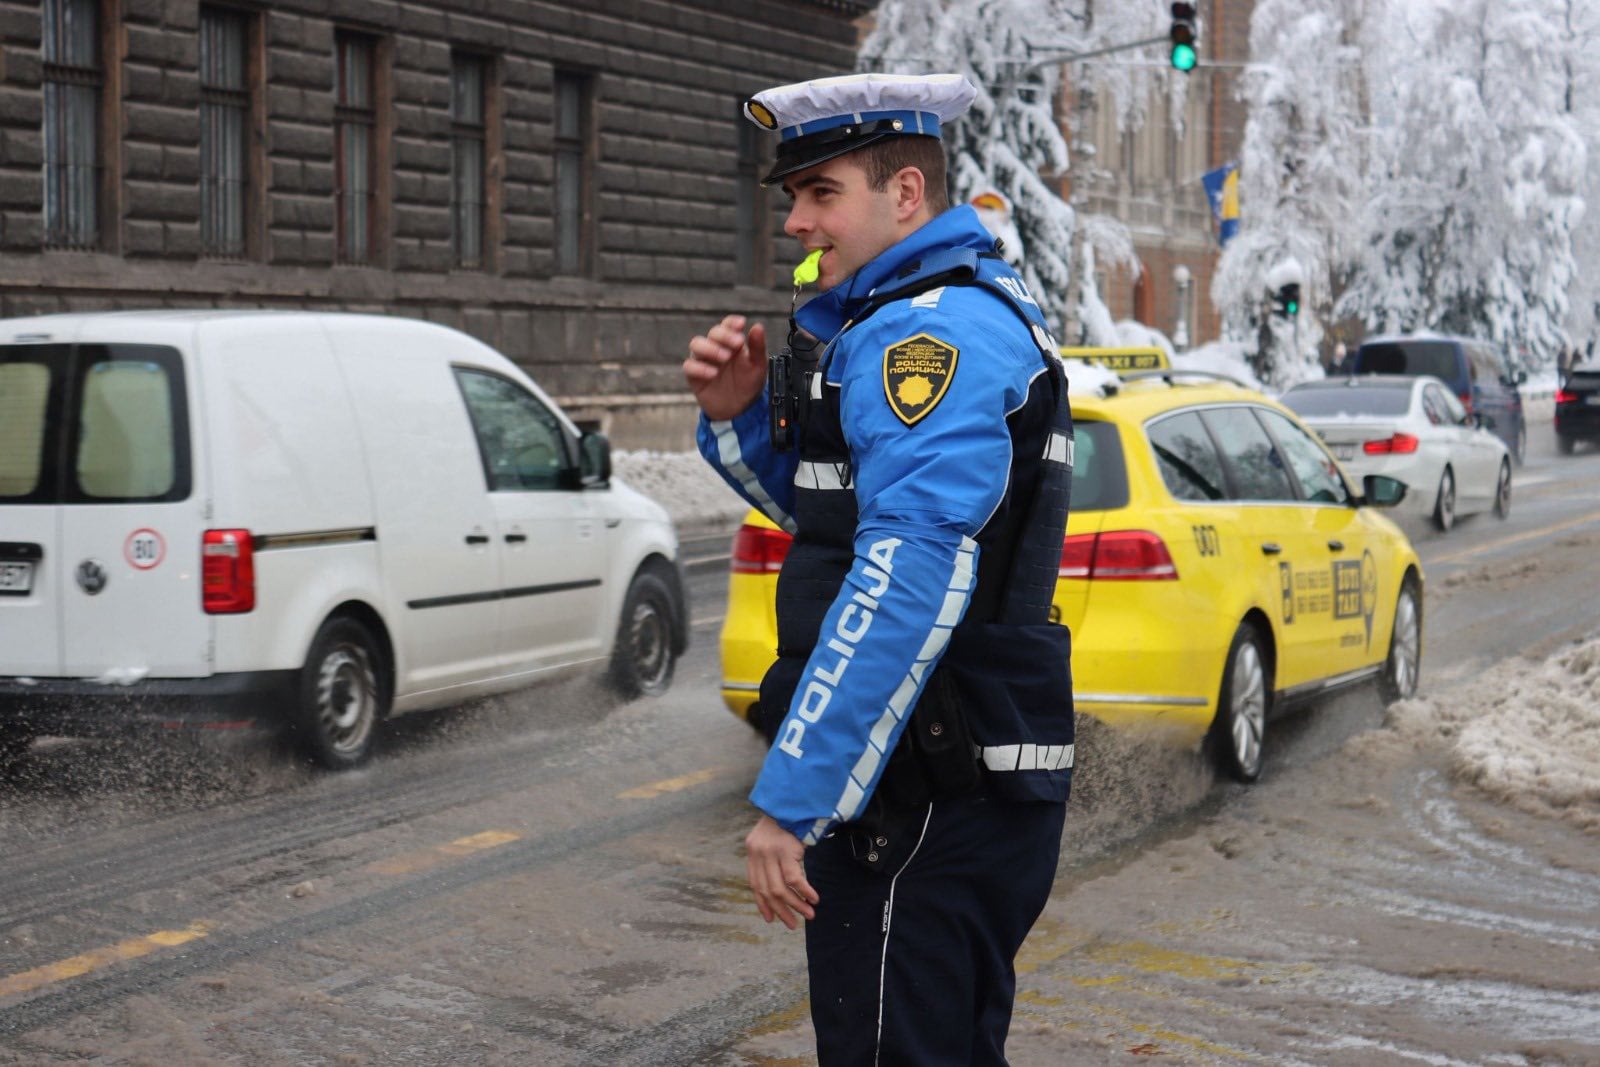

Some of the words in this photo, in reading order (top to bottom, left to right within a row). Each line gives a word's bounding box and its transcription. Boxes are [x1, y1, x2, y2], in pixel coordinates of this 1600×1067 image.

[895, 360, 942, 368] POLICIJA
[889, 366, 946, 376] ПОЛИЦИЈА
[778, 537, 903, 760] POLICIJA
